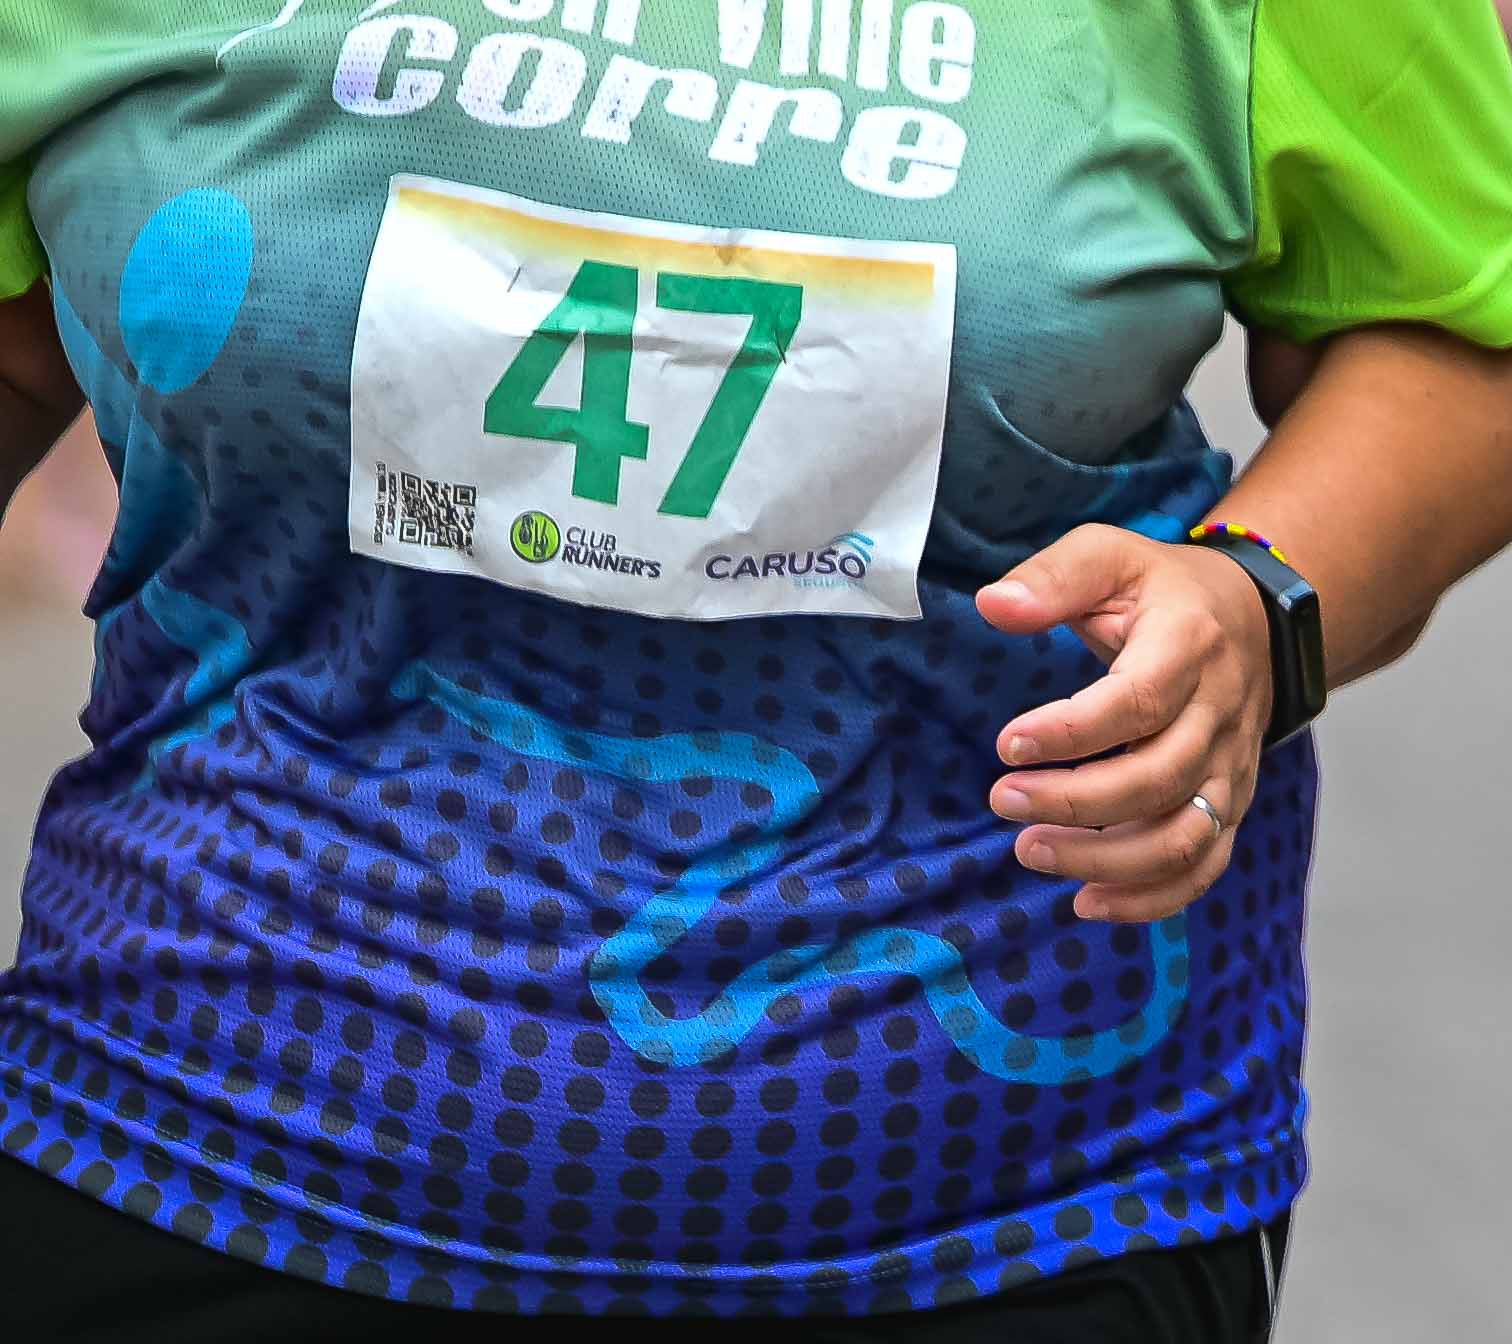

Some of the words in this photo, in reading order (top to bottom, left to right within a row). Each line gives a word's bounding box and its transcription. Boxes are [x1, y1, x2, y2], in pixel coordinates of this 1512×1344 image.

[332, 14, 967, 199] corre
[483, 259, 803, 521] 47
[566, 525, 618, 552] CLUB
[561, 544, 663, 579] RUNNER'S
[704, 545, 867, 580] CARUSO
